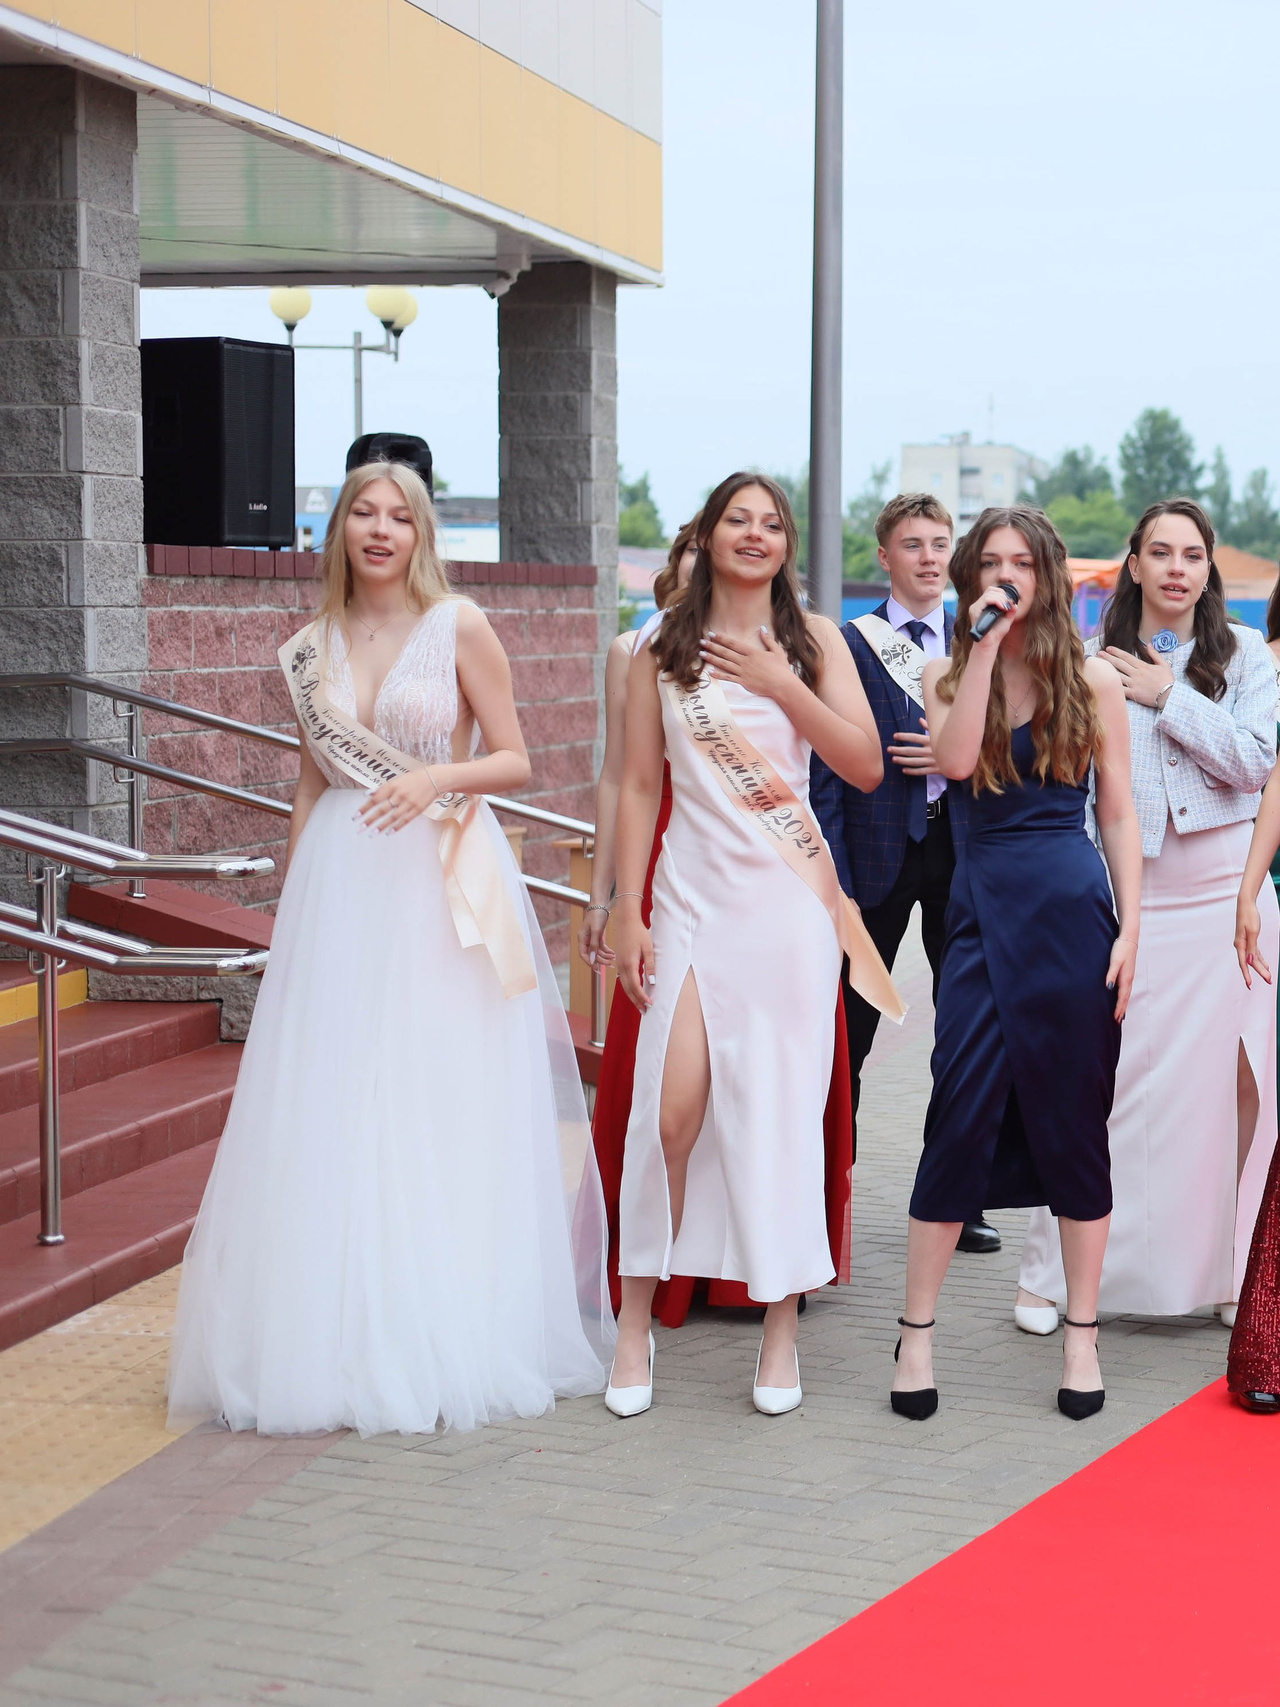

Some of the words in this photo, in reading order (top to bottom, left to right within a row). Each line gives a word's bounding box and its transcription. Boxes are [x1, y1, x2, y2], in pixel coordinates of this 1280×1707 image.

[300, 672, 396, 781] Выпускниц
[435, 790, 468, 809] 24
[682, 708, 694, 728] класс
[685, 671, 777, 814] Выпускница
[770, 808, 820, 859] 2024
[707, 749, 727, 774] Средняя
[726, 774, 740, 793] школа
